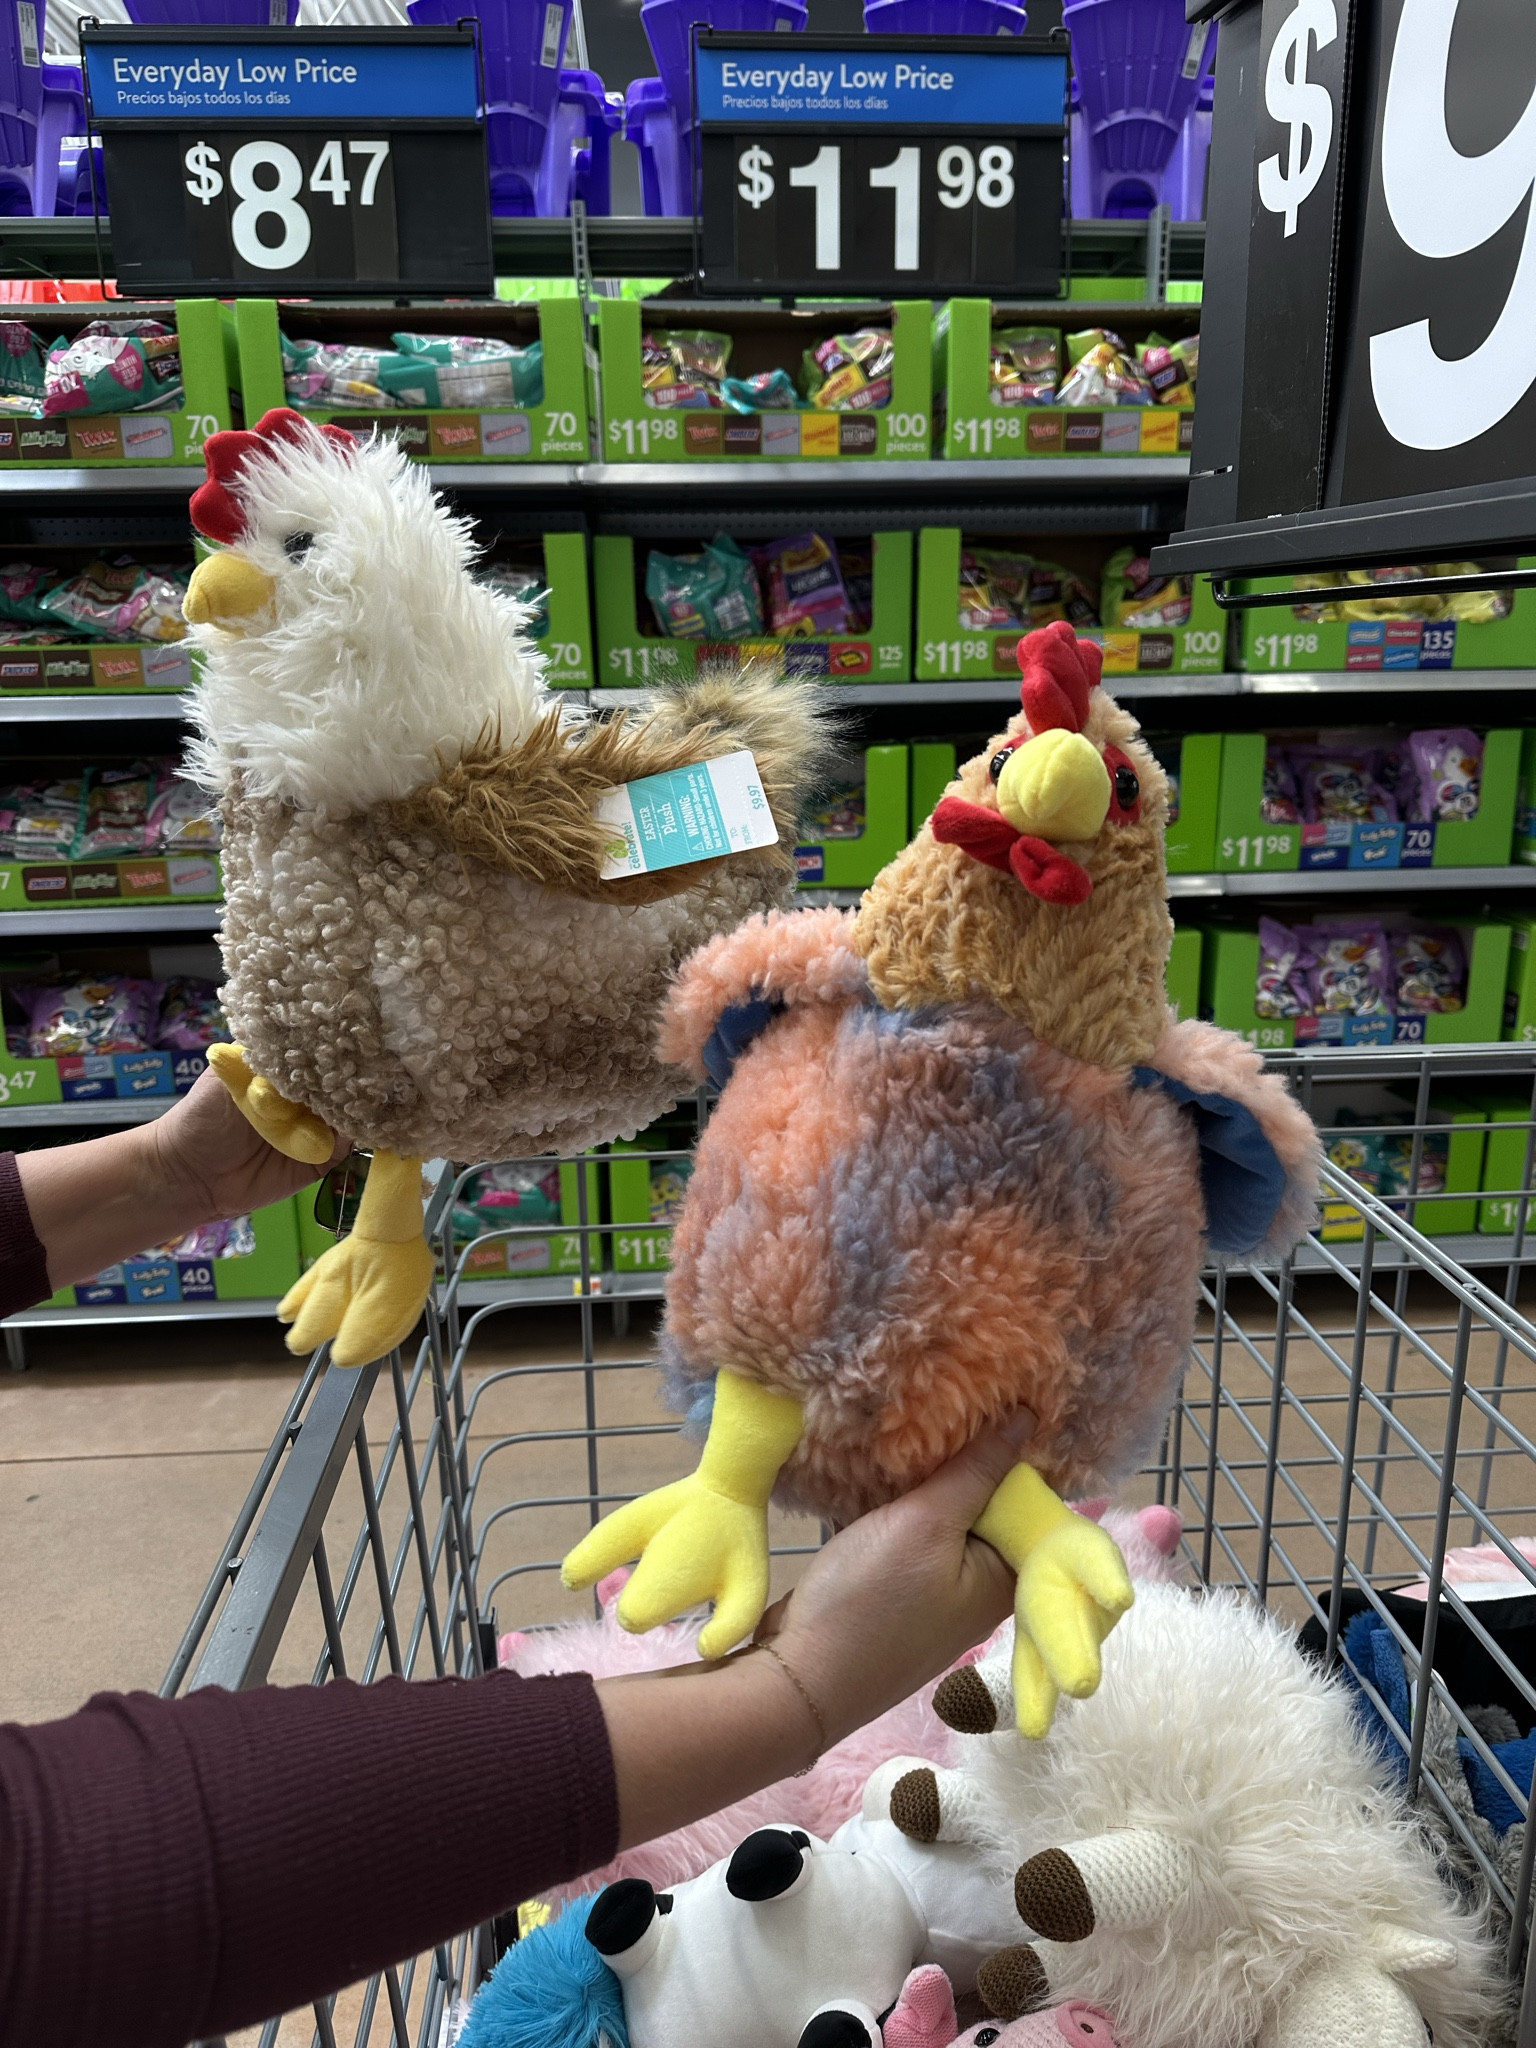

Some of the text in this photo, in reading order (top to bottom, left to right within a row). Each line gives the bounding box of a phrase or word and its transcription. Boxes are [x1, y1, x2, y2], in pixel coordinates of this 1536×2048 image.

[113, 57, 358, 91] Everyday Low Price
[722, 62, 954, 96] Everyday Low Price
[117, 91, 291, 108] Precios bajos todos los días
[722, 95, 889, 112] Precios bajos todos los días
[544, 411, 577, 437] 70
[885, 413, 926, 438] 100
[541, 439, 584, 455] pieces
[885, 440, 926, 454] pieces
[1182, 631, 1221, 653] 100
[1421, 630, 1454, 649] 135
[550, 643, 582, 666] 70
[879, 646, 903, 661] 125
[747, 785, 765, 810] $9.97
[639, 806, 656, 841] EASTER
[657, 802, 678, 835] Plush
[679, 795, 700, 837] WARNING:
[621, 821, 641, 869] celebrate!
[1406, 829, 1432, 848] 70
[1397, 1021, 1421, 1039] 70
[176, 1058, 205, 1076] 40
[182, 1267, 211, 1286] 40
